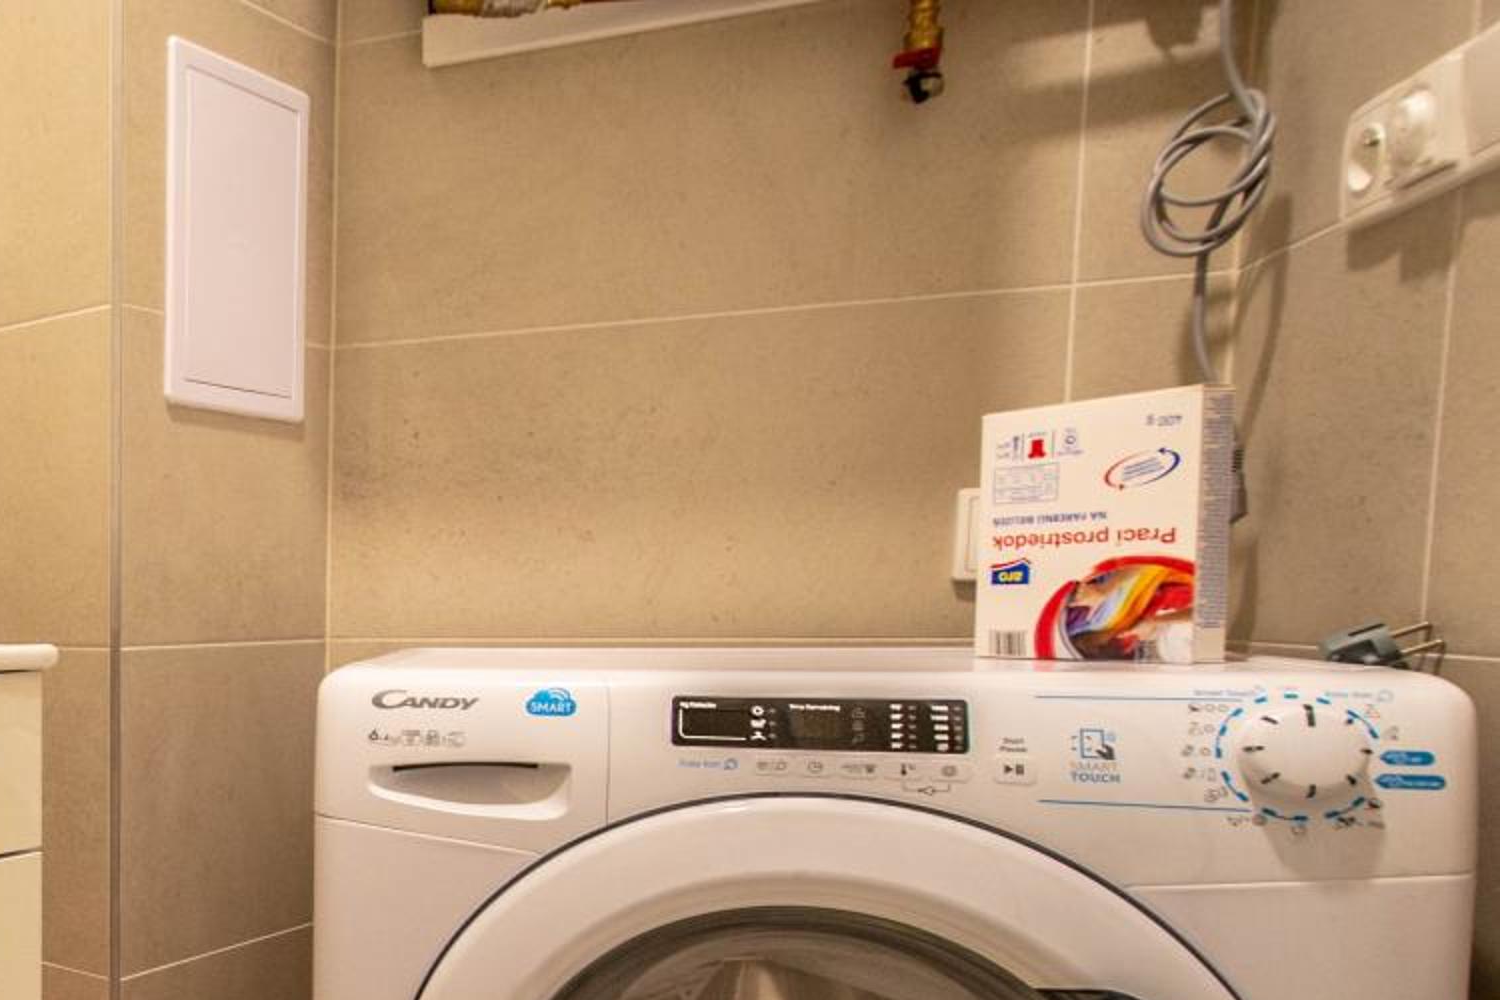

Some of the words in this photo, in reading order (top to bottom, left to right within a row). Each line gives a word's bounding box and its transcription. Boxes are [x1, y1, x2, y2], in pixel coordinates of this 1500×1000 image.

[993, 526, 1109, 551] prostriedok
[530, 701, 572, 714] SMART
[1069, 771, 1122, 783] TOUCH
